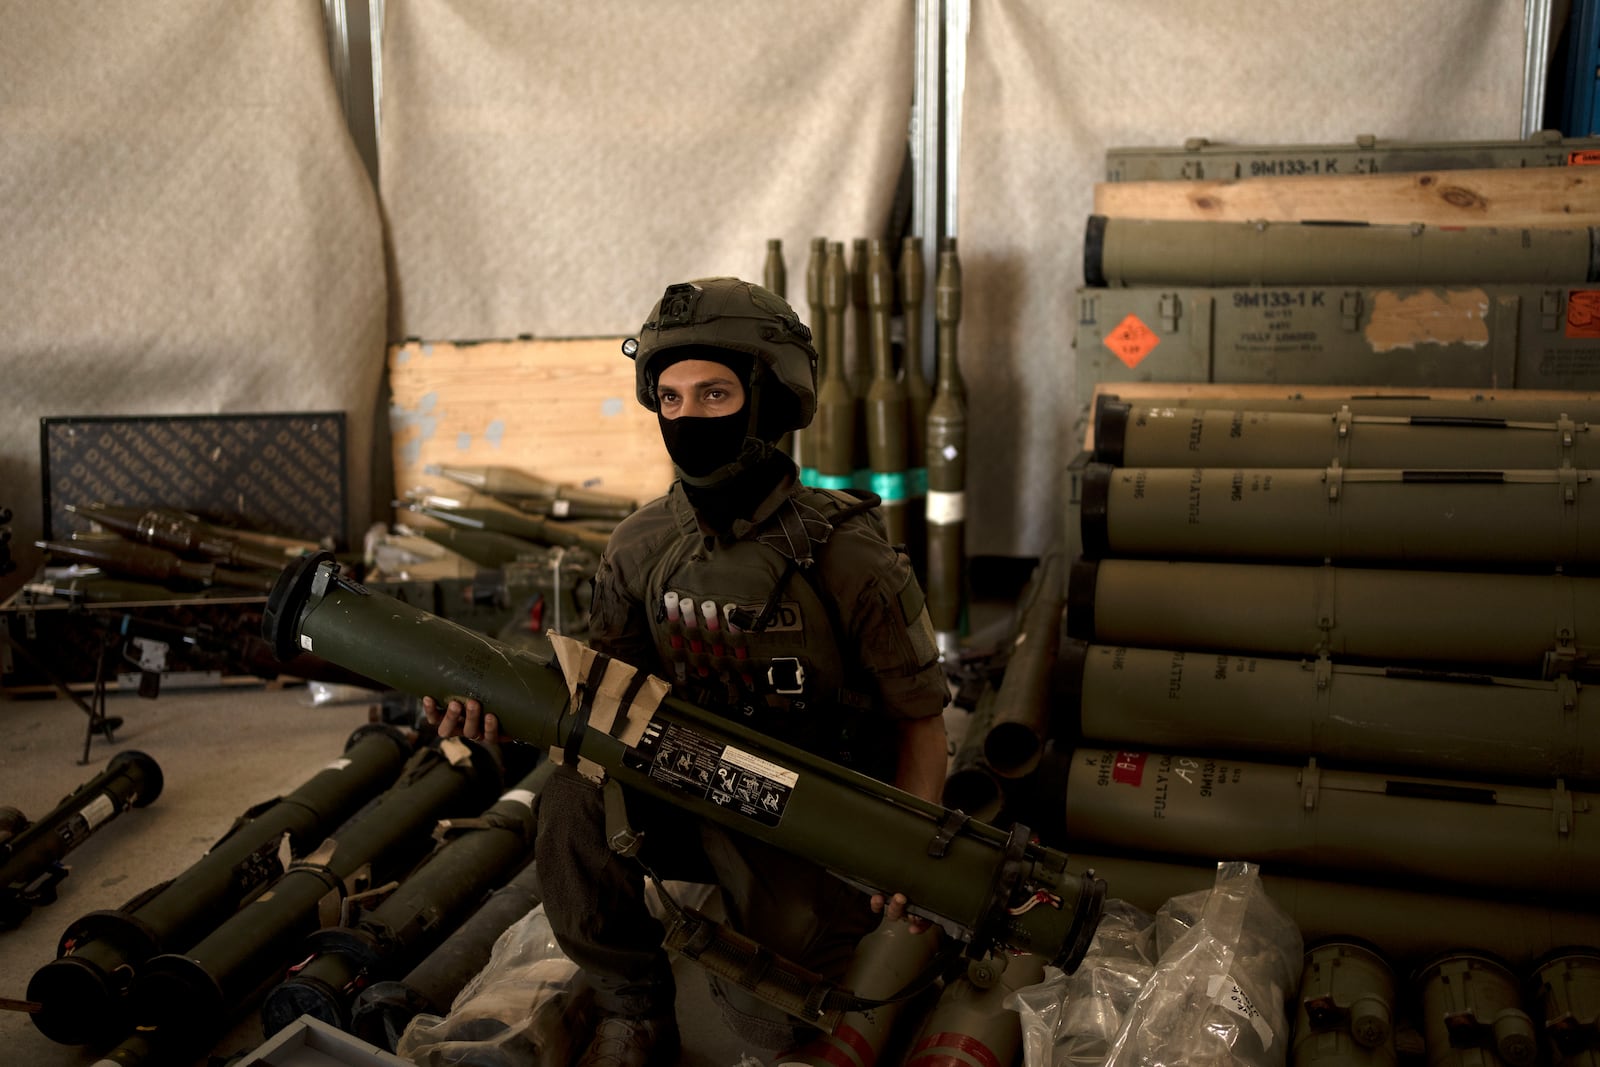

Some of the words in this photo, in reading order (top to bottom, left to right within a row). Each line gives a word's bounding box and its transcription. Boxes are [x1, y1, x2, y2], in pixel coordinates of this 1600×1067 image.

[1250, 159, 1320, 176] 9M133-1
[1325, 158, 1338, 173] K
[1233, 292, 1305, 307] 9M133-1
[1312, 292, 1325, 306] K
[1188, 486, 1201, 525] FULLY
[1168, 662, 1183, 700] FULLY
[1153, 775, 1170, 820] FULLY
